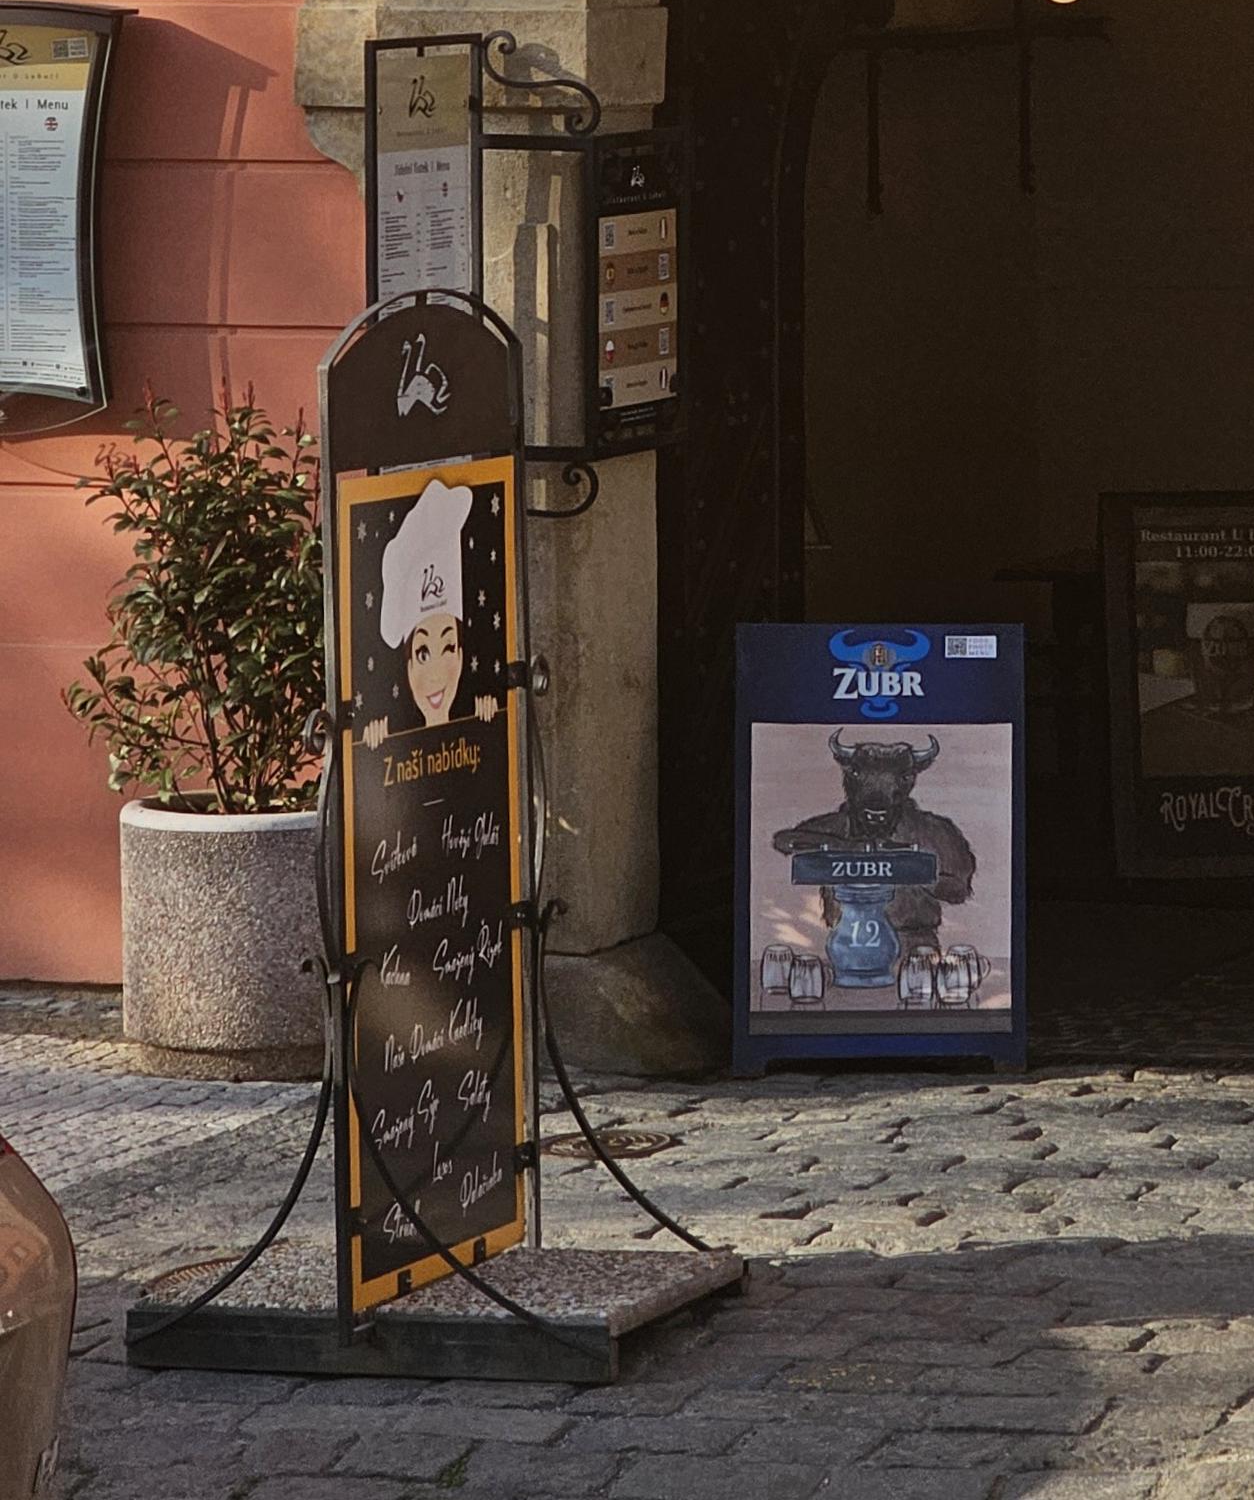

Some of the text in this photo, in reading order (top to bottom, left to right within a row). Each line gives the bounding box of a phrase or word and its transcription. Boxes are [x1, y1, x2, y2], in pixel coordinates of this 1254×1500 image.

[37, 99, 69, 110] Menu
[1140, 528, 1226, 541] Restaurant
[832, 667, 925, 700] ZUBR
[383, 737, 480, 788] Z naší nabídky:
[1160, 792, 1220, 832] ROYAL
[831, 861, 893, 877] ZUBR
[848, 920, 881, 947] 12
